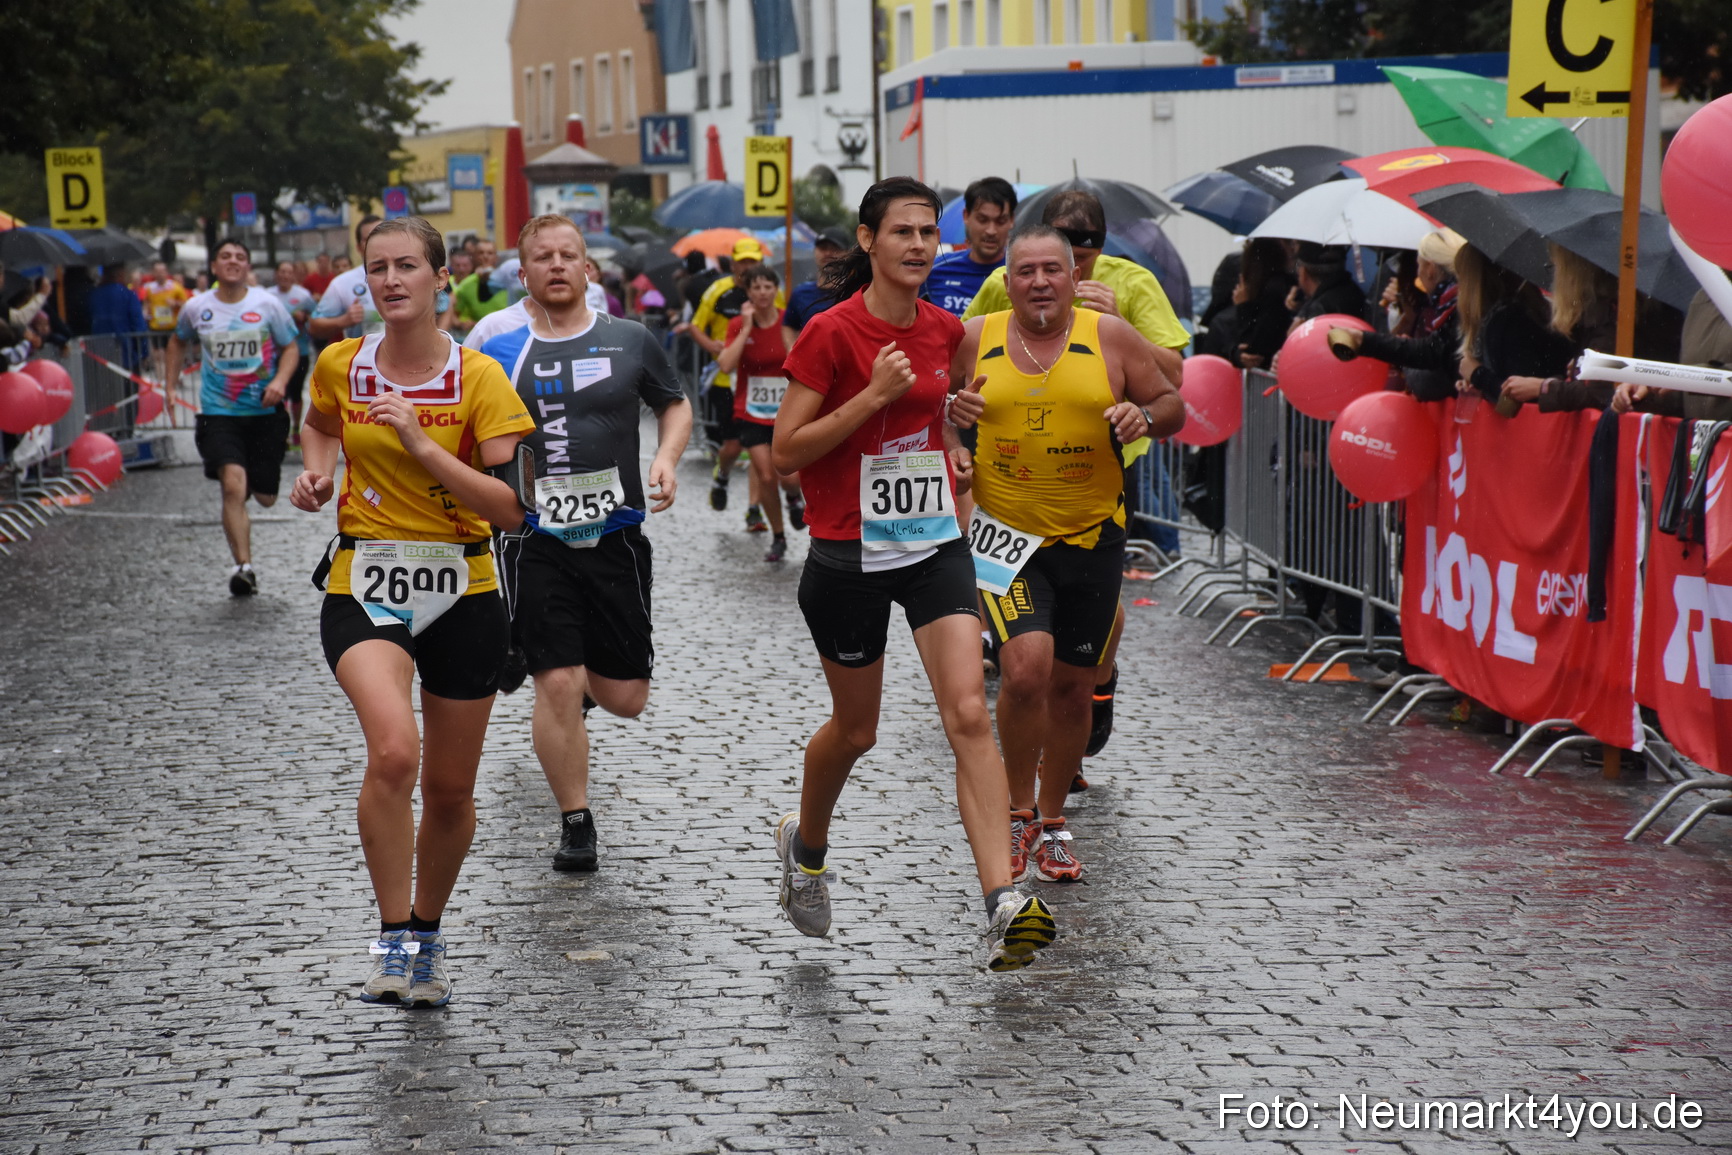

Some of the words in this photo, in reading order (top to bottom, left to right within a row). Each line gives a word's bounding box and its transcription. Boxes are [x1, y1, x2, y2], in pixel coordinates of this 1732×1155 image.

[1546, 0, 1615, 73] C
[750, 139, 786, 153] Block
[52, 151, 94, 167] Block
[757, 161, 781, 198] D
[62, 173, 90, 211] D
[217, 340, 257, 358] 2770
[752, 385, 785, 402] 2312
[347, 409, 394, 427] MA
[420, 409, 463, 427] ÖGL
[996, 443, 1019, 455] Seidl
[907, 456, 941, 467] BOCK
[572, 472, 613, 487] BOCK
[872, 476, 943, 515] 3077
[546, 490, 618, 523] 2253
[970, 518, 1029, 564] 3028
[404, 545, 459, 558] BOCK
[1011, 582, 1031, 609] Run!
